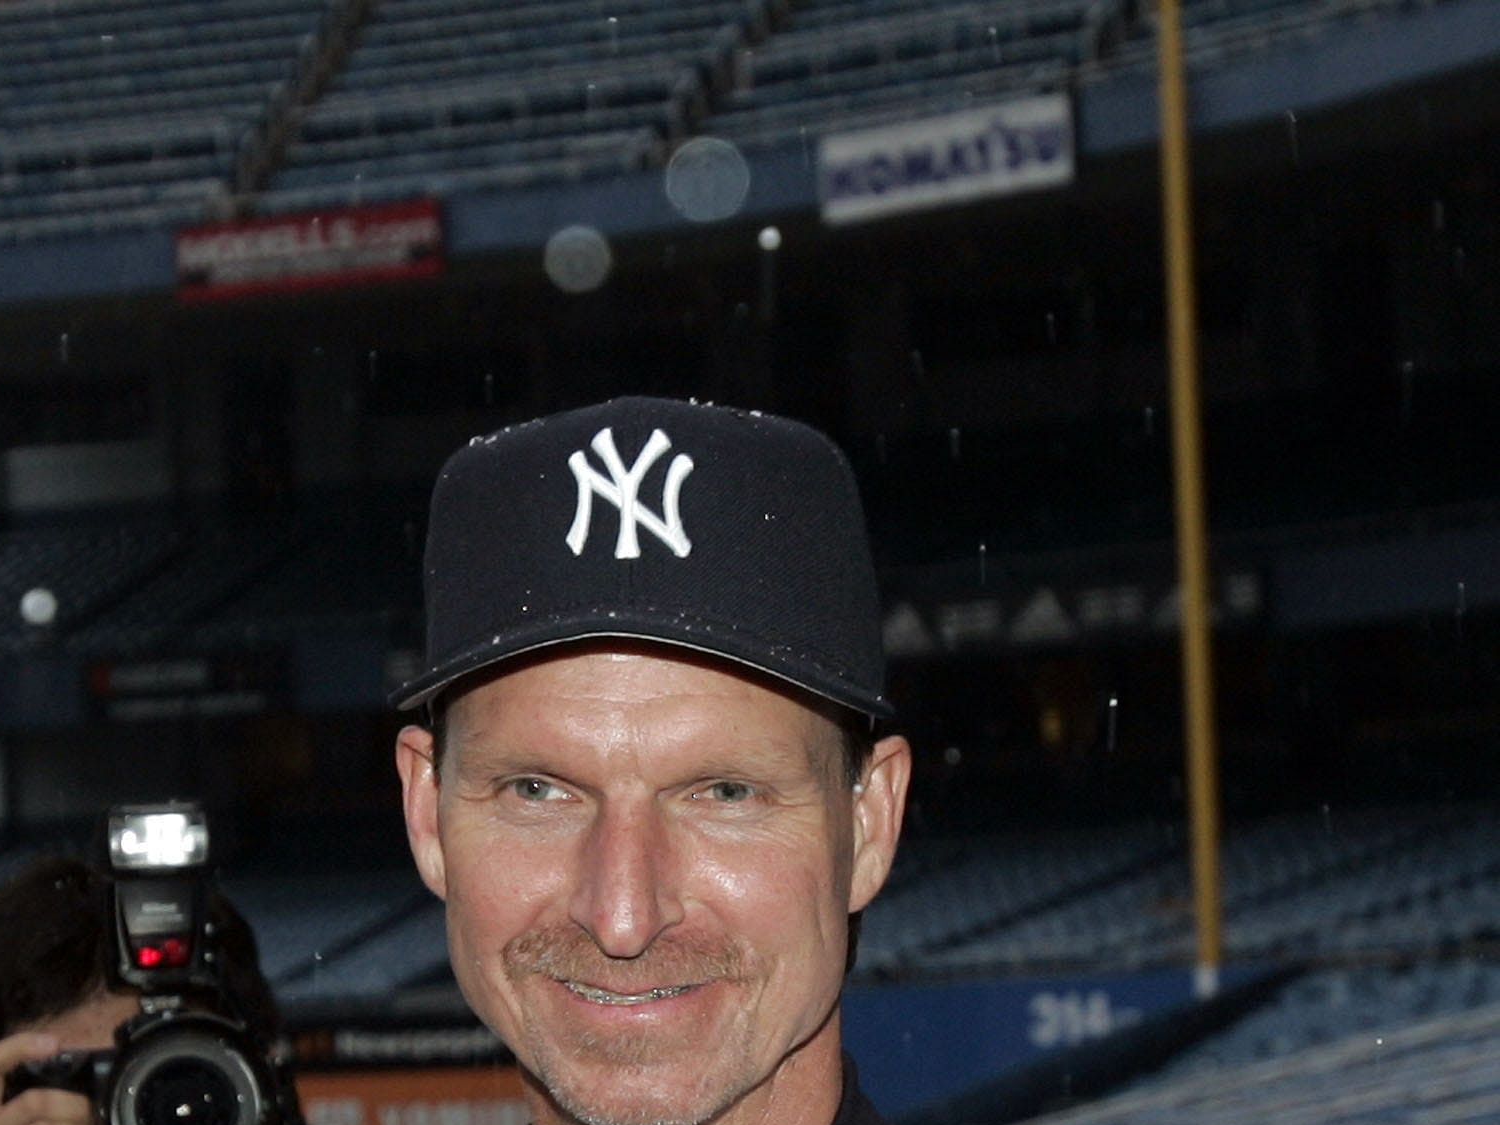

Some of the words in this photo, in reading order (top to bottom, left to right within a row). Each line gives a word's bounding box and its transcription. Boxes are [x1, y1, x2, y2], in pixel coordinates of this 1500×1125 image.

[825, 118, 1064, 202] KOMATSU
[564, 426, 695, 560] NY
[1030, 993, 1112, 1046] 314
